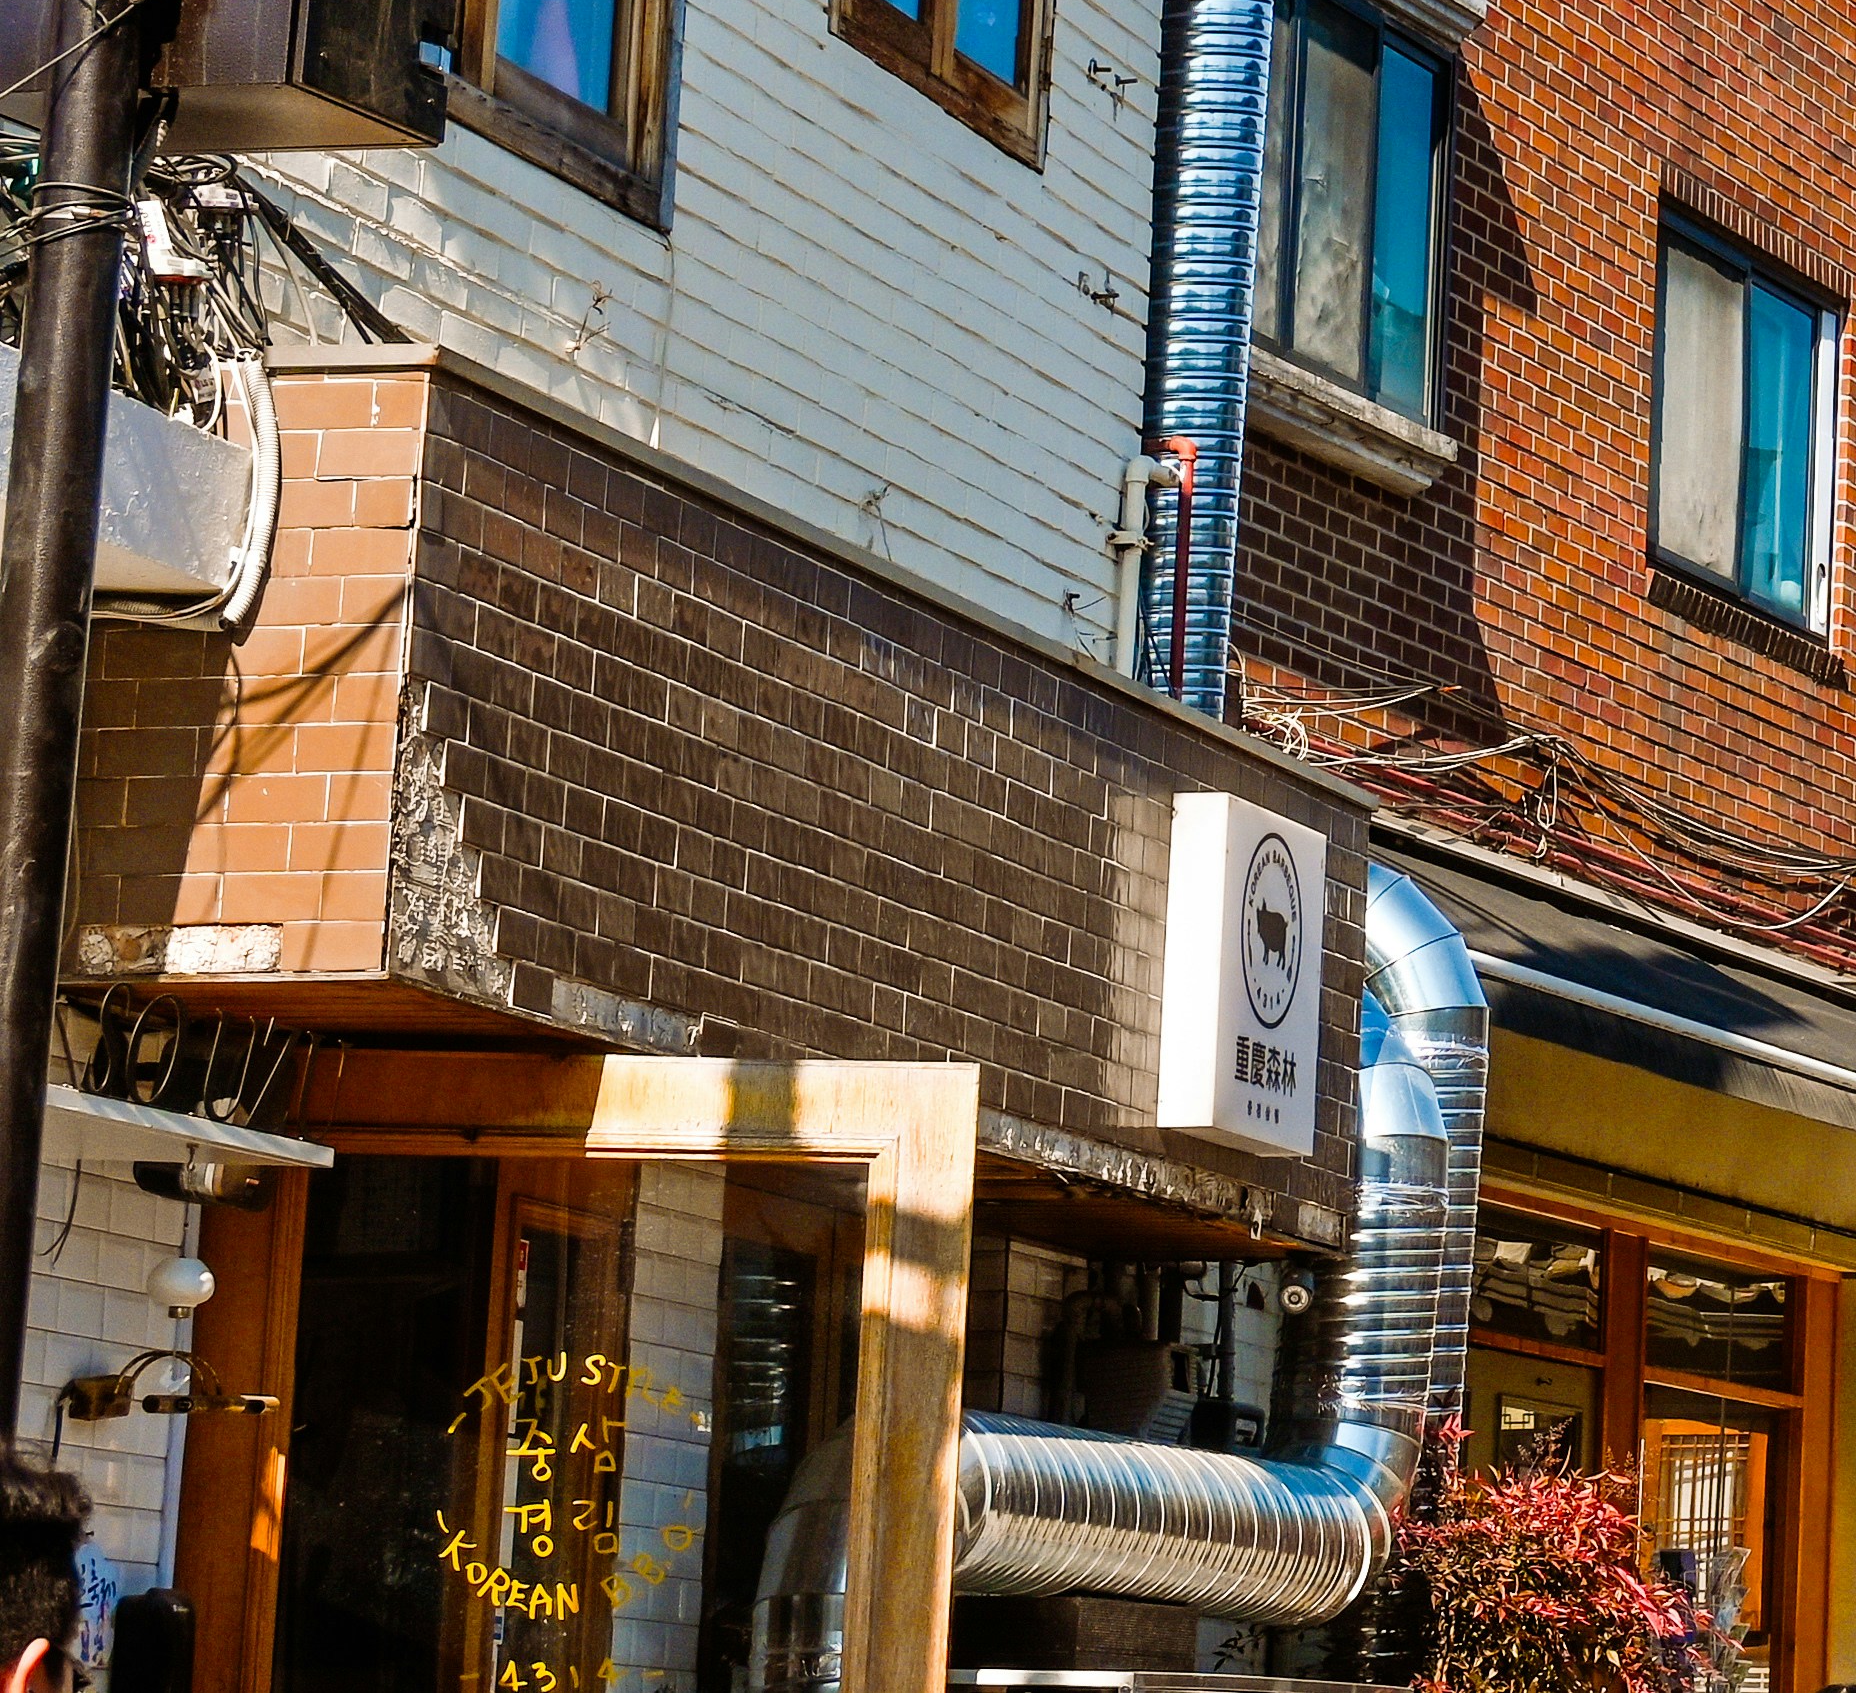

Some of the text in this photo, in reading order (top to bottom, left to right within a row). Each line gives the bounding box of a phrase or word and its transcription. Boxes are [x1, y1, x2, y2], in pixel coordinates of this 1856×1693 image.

[1247, 848, 1298, 923] KOREAN BARBEQUE
[1234, 1035, 1297, 1097] 重慶森林
[463, 1352, 567, 1410] JEJU
[438, 1529, 581, 1621] KOREAN
